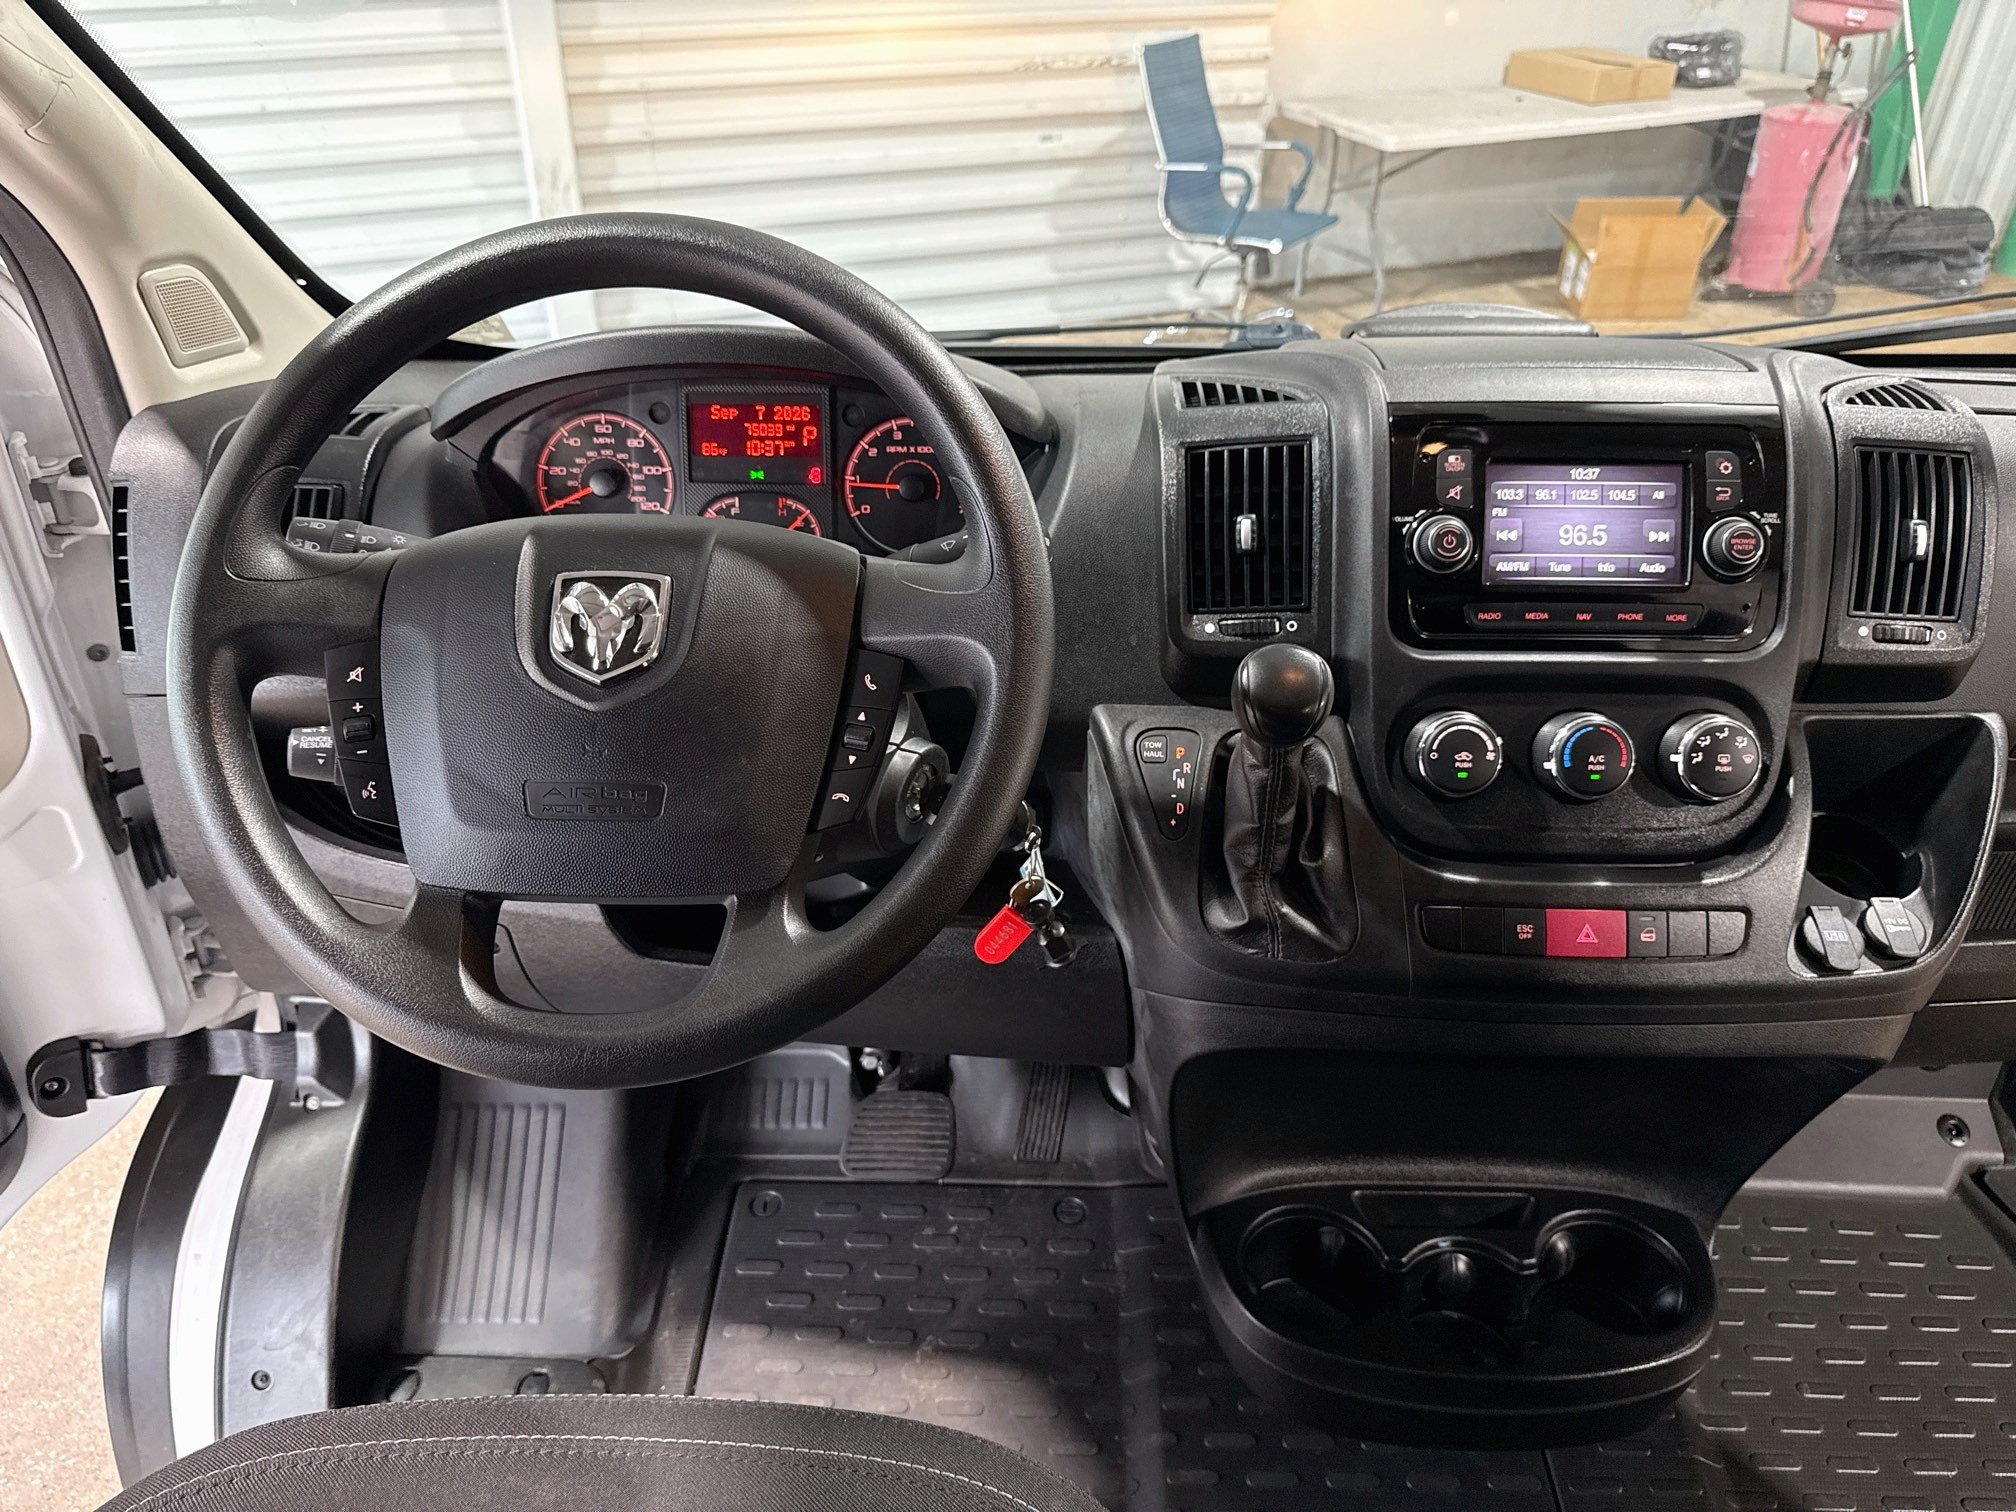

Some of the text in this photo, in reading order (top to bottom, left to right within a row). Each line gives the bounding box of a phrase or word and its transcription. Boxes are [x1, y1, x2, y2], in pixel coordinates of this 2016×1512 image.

[710, 404, 811, 421] Sep 7 2026
[594, 424, 613, 434] 60
[744, 423, 783, 437] 75039
[802, 425, 818, 447] P
[893, 430, 903, 441] 3
[563, 438, 581, 447] 40
[592, 437, 615, 445] MPH
[626, 438, 645, 448] 80
[746, 440, 785, 457] 10:37
[868, 447, 878, 457] 2
[886, 445, 908, 453] RPM
[549, 466, 567, 475] 20
[642, 466, 662, 475] 100
[1496, 488, 1525, 501] 103.3
[1535, 488, 1558, 501] 96.1
[1570, 489, 1599, 501] 102.5
[1607, 489, 1636, 501] 104.5
[640, 501, 661, 511] 120
[860, 504, 871, 514] 0
[1491, 507, 1508, 517] FM
[1558, 524, 1608, 546] 96.5
[1495, 561, 1530, 572] AM/FM
[1548, 561, 1573, 572] Tune
[1597, 562, 1616, 573] Info
[1639, 562, 1667, 574] Audio
[1477, 612, 1502, 620] RADIO
[1524, 612, 1549, 620] MEDIA
[1617, 613, 1644, 621] PHONE
[1665, 614, 1688, 622] MORE
[1144, 741, 1163, 749] TOW
[1175, 747, 1186, 759] P
[1588, 754, 1606, 764] A/C
[1183, 762, 1192, 774] R
[1176, 777, 1185, 789] N
[1176, 802, 1185, 815] D
[1516, 924, 1534, 933] ESC
[1518, 932, 1532, 940] OFF
